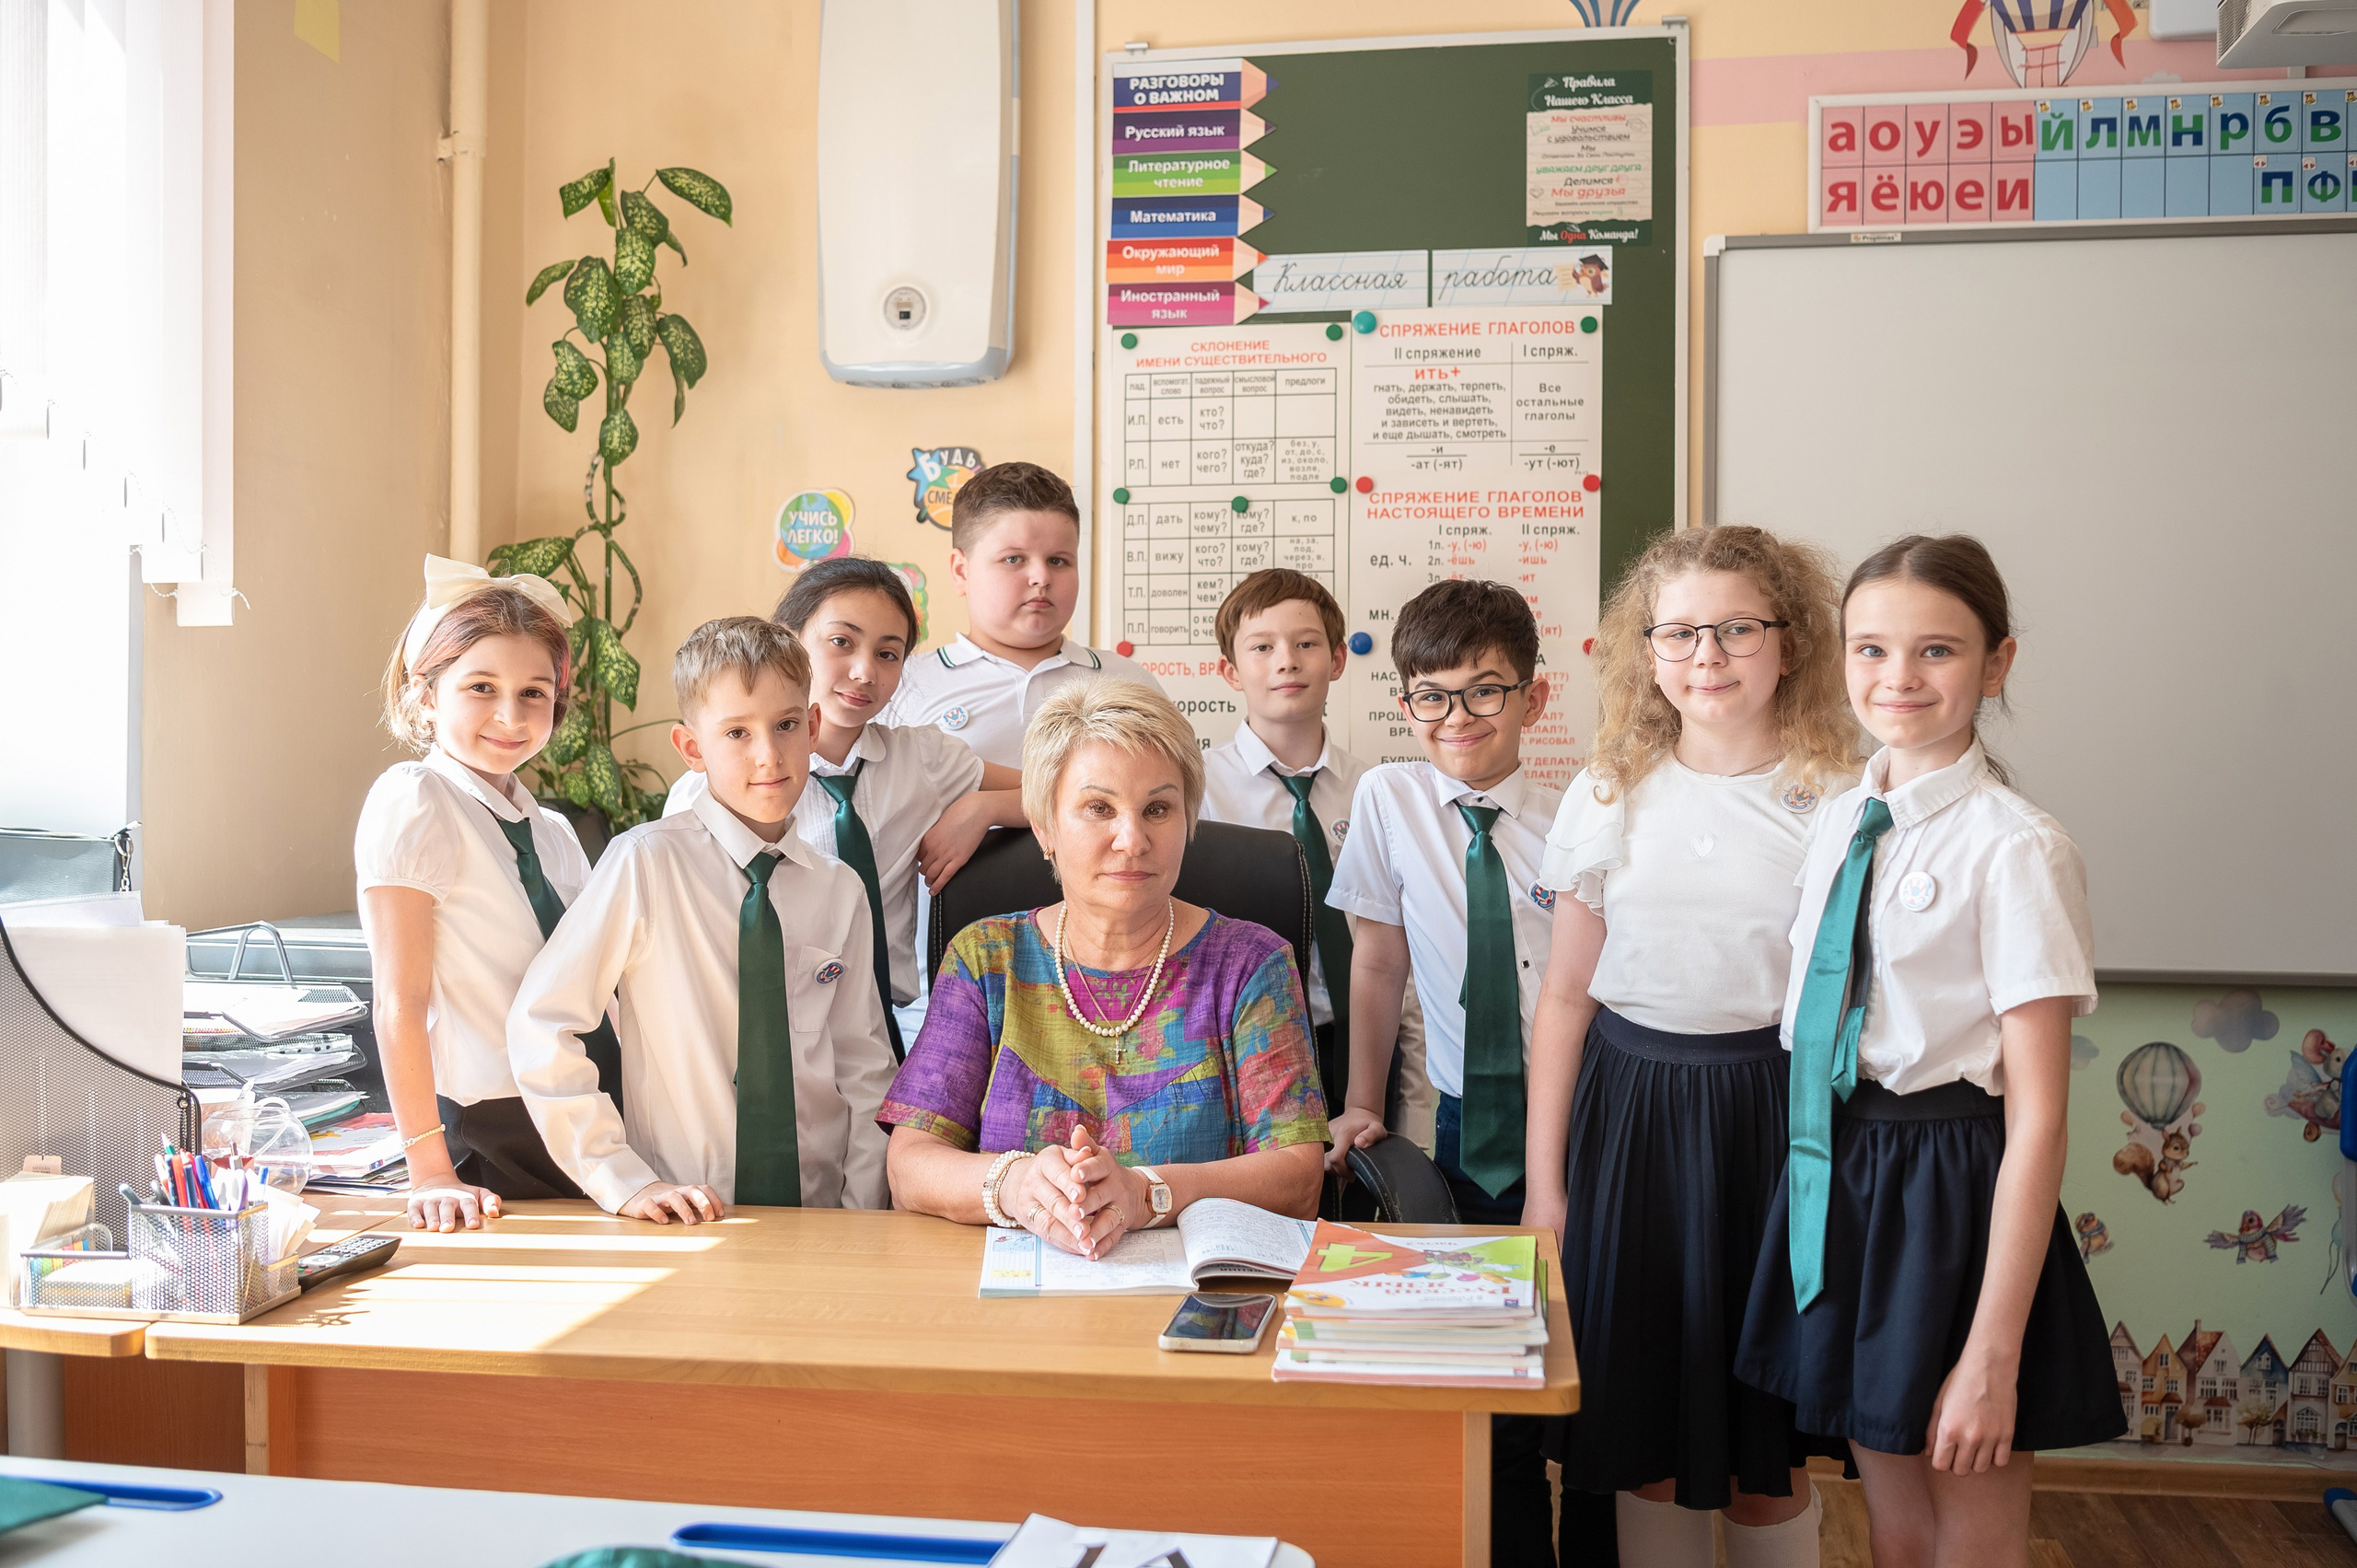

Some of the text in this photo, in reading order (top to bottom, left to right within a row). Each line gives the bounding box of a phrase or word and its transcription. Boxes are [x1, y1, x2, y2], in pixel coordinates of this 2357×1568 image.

[1130, 74, 1224, 90] РАЗГОВОРЫ
[1562, 74, 1616, 92] Правила
[1133, 88, 1219, 105] О ВАЖНОМ
[1544, 93, 1634, 107] Нашего Класса
[1125, 124, 1225, 142] Русский язык
[1554, 134, 1631, 144] удовольствием
[1128, 158, 1230, 174] Литературное
[1154, 177, 1203, 188] чтение
[1563, 177, 1613, 187] Делимся
[1550, 188, 1626, 199] Мы друзья
[1130, 210, 1216, 223] Математика
[1539, 228, 1639, 244] Мы Одна Команда!
[1122, 244, 1220, 261] Окружающий
[1155, 264, 1185, 276] мир
[1273, 255, 1557, 301] Классная работа
[1120, 289, 1220, 303] Иностранный
[1151, 308, 1188, 319] язык
[1379, 320, 1574, 338] СПРЯЖЕНИЕ ГЛАГОЛОВ
[1190, 340, 1270, 353] СКЛОНЕНИЕ
[1530, 346, 1578, 359] спряж.
[1136, 353, 1327, 368] ИМЕНИ СУЩЕСТВИТЕЛЬНОГО
[1406, 348, 1481, 362] спряжение
[1194, 376, 1230, 385] падежный
[1235, 375, 1275, 384] смысловой
[1285, 377, 1326, 388] предлоги
[1130, 383, 1146, 391] пад.
[1200, 387, 1225, 396] вопрос
[1242, 386, 1268, 395] вопрос
[1374, 382, 1506, 394] гнать, держать, терпеть,
[1539, 383, 1562, 393] Все
[1387, 394, 1492, 405] обидеть, слышать,
[1516, 398, 1584, 407] остальные
[1200, 406, 1225, 417] кто?
[1386, 405, 1493, 417] видеть, ненавидеть
[1525, 412, 1575, 421] глаголы
[1158, 416, 1184, 424] есть
[1200, 420, 1225, 430] что?
[1391, 419, 1440, 427] зависеть
[1452, 417, 1498, 429] вертеть,
[1382, 431, 1403, 440] еще
[1406, 430, 1453, 440] дышать,
[1456, 429, 1506, 440] смотреть
[1235, 440, 1274, 453] откуда?
[1197, 448, 1227, 459] кого?
[1161, 460, 1180, 470] нет
[1240, 454, 1269, 467] куда?
[1411, 459, 1463, 471] -ат (-ят)
[1524, 457, 1580, 470] -ут (-ют)
[1197, 462, 1227, 473] чего?
[1244, 467, 1265, 478] где?
[1369, 491, 1582, 505] СПРЯЖЕНИЕ ГЛАГОЛОВ
[788, 510, 838, 527] УЧИСЬ
[1194, 508, 1227, 522] кому?
[1366, 505, 1584, 520] НАСТОЯЩЕГО ВРЕМЕНИ
[1156, 516, 1183, 526] дать
[1304, 515, 1318, 523] по
[1194, 522, 1227, 535] чему?
[1241, 521, 1265, 534] где?
[1446, 527, 1492, 538] спряж.
[1533, 526, 1580, 538] спряж.
[786, 528, 839, 544] ЛЕГКО!
[1195, 542, 1225, 554] кого?
[1237, 540, 1270, 554] кому?
[1155, 552, 1184, 563] вижу
[1198, 555, 1224, 567] что?
[1241, 554, 1265, 567] где?
[1370, 554, 1412, 568] ед. ч.
[1518, 556, 1547, 564] -ишь
[1295, 563, 1313, 571] про
[1197, 578, 1224, 589] кем?
[1518, 574, 1535, 583] -ит
[1151, 589, 1189, 598] доволен
[1197, 591, 1225, 603] чем?
[1193, 616, 1200, 624] о
[1369, 610, 1395, 621] мн.
[1151, 625, 1189, 635] говорить
[1193, 629, 1200, 637] о
[1141, 662, 1195, 678] ОРОСТЬ,
[1176, 701, 1237, 716] орость
[1524, 771, 1572, 780] ЕЛАЕТ?)
[1317, 1243, 1392, 1272] 4
